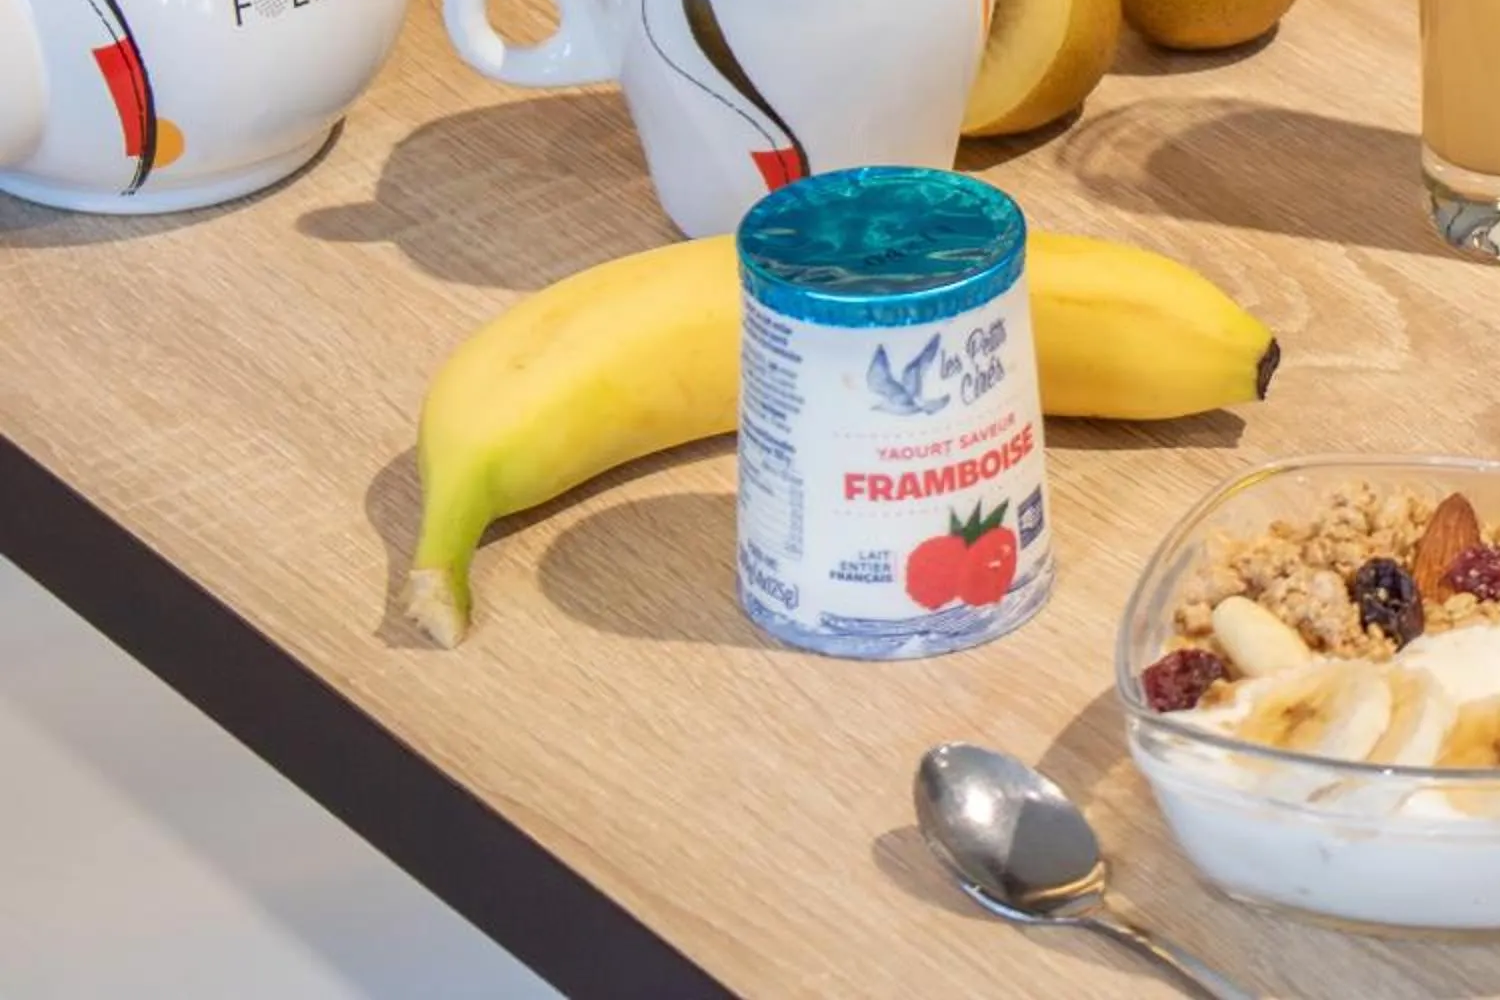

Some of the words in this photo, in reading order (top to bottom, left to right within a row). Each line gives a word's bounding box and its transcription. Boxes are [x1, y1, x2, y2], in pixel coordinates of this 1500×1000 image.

[876, 440, 953, 461] YAOURT
[960, 413, 1015, 449] SAVEUR
[844, 424, 1033, 501] FRAMBOISE
[859, 549, 891, 561] LAIT
